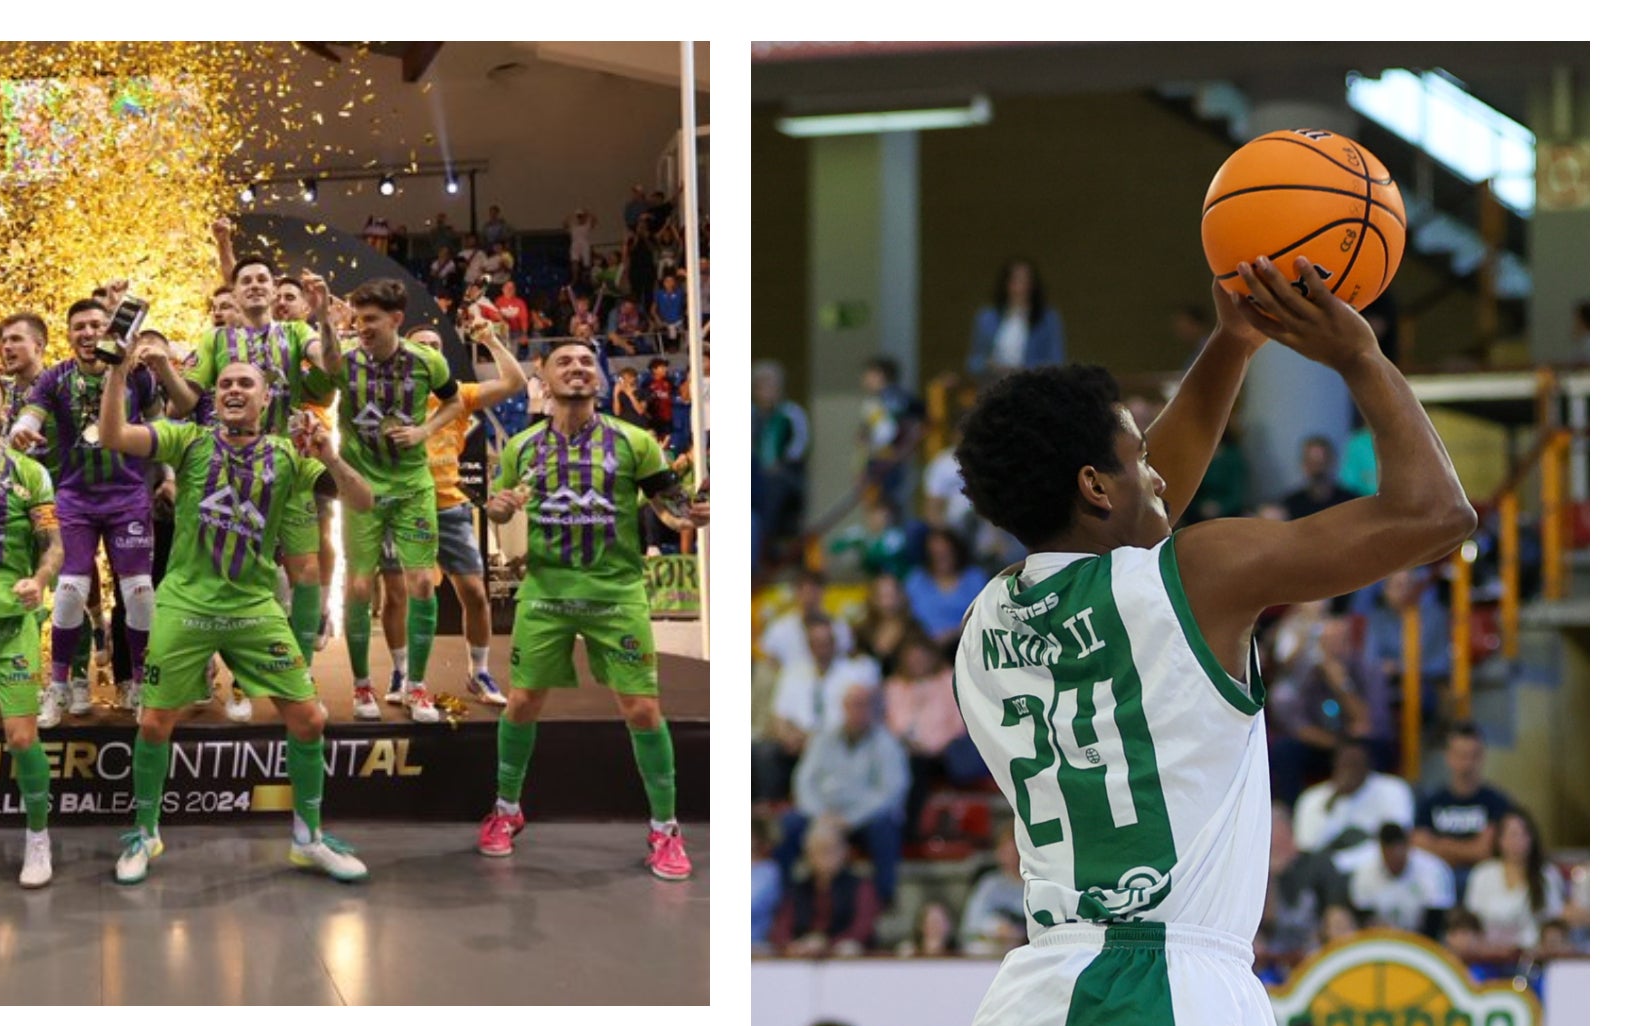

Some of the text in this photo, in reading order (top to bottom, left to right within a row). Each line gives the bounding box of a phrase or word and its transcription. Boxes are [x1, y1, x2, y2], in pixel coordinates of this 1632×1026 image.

[1062, 606, 1106, 660] II
[1000, 677, 1139, 848] 24
[59, 791, 180, 815] BALEAS
[186, 790, 251, 813] 2024
